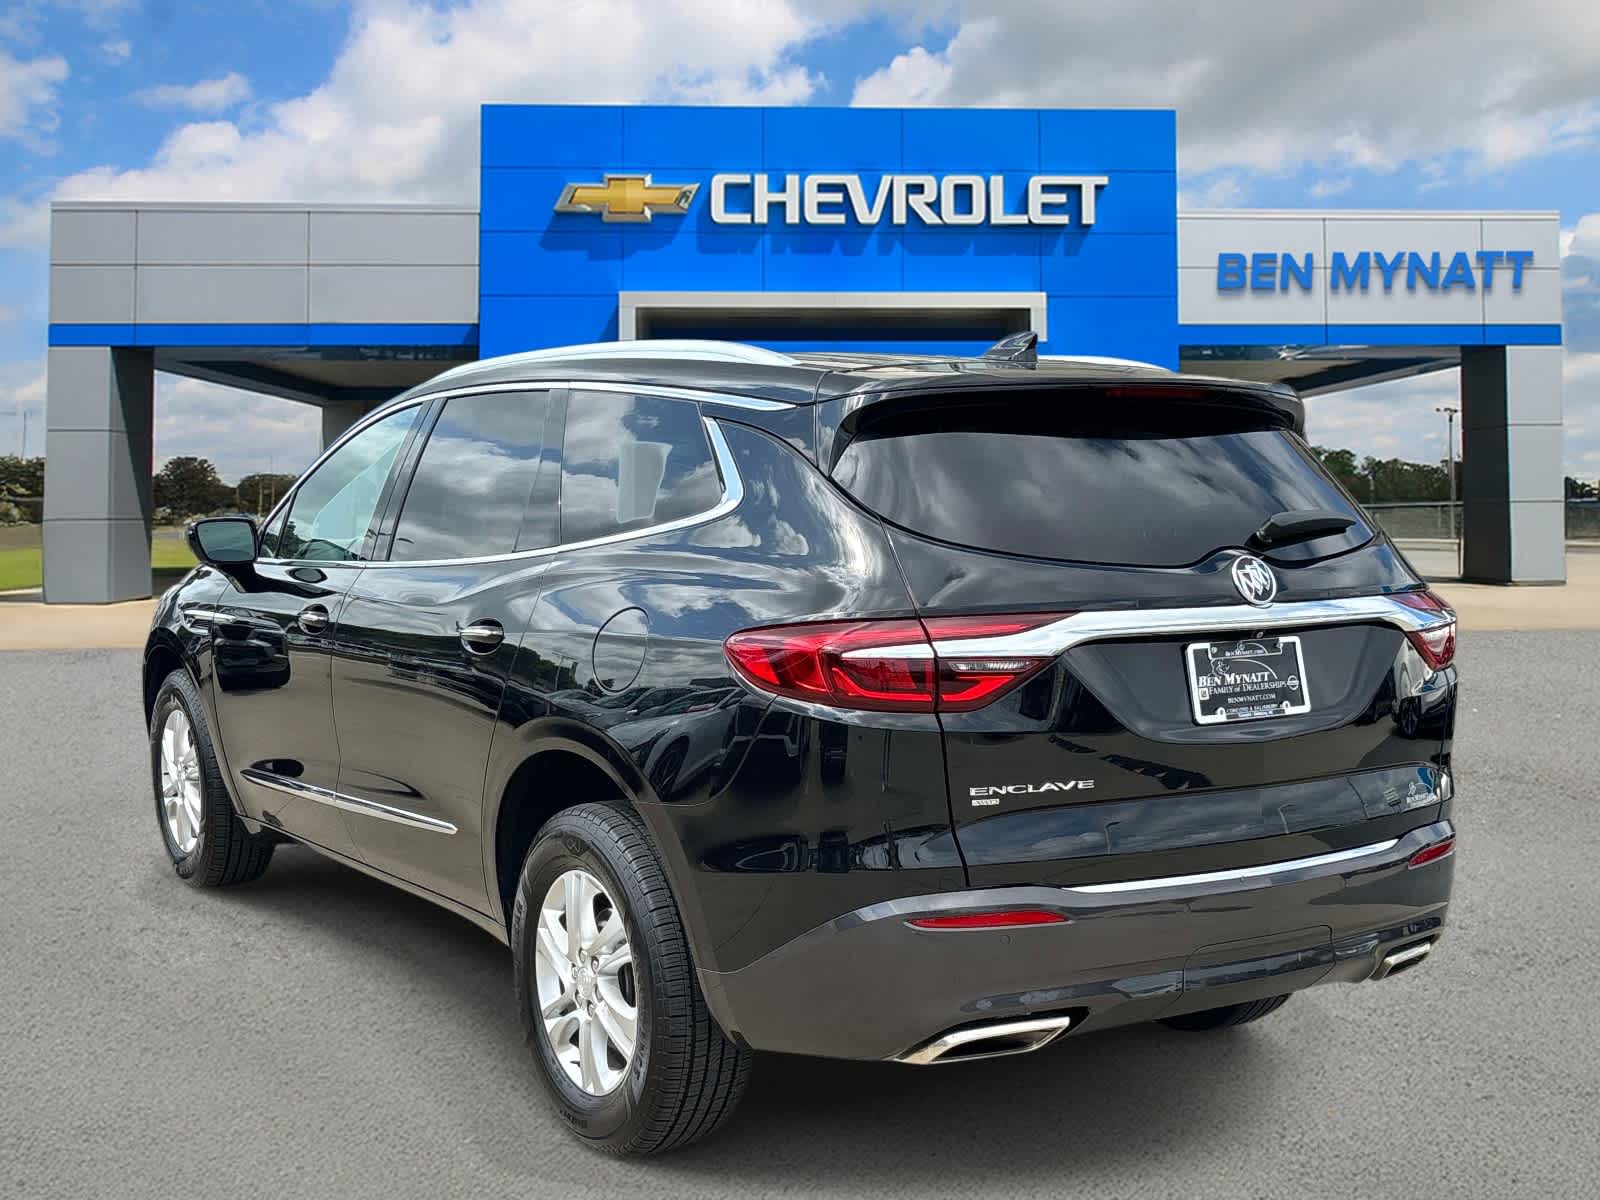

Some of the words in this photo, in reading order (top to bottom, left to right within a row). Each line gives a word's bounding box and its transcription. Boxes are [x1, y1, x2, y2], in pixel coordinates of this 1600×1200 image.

[711, 173, 1109, 225] CHEVROLET
[1217, 252, 1313, 290] BEN
[1330, 250, 1534, 290] MYNATT
[1199, 675, 1222, 687] BEN
[1225, 672, 1270, 685] MYNATT
[1210, 686, 1233, 695] FAMILY
[970, 779, 1095, 796] ENCLAVE
